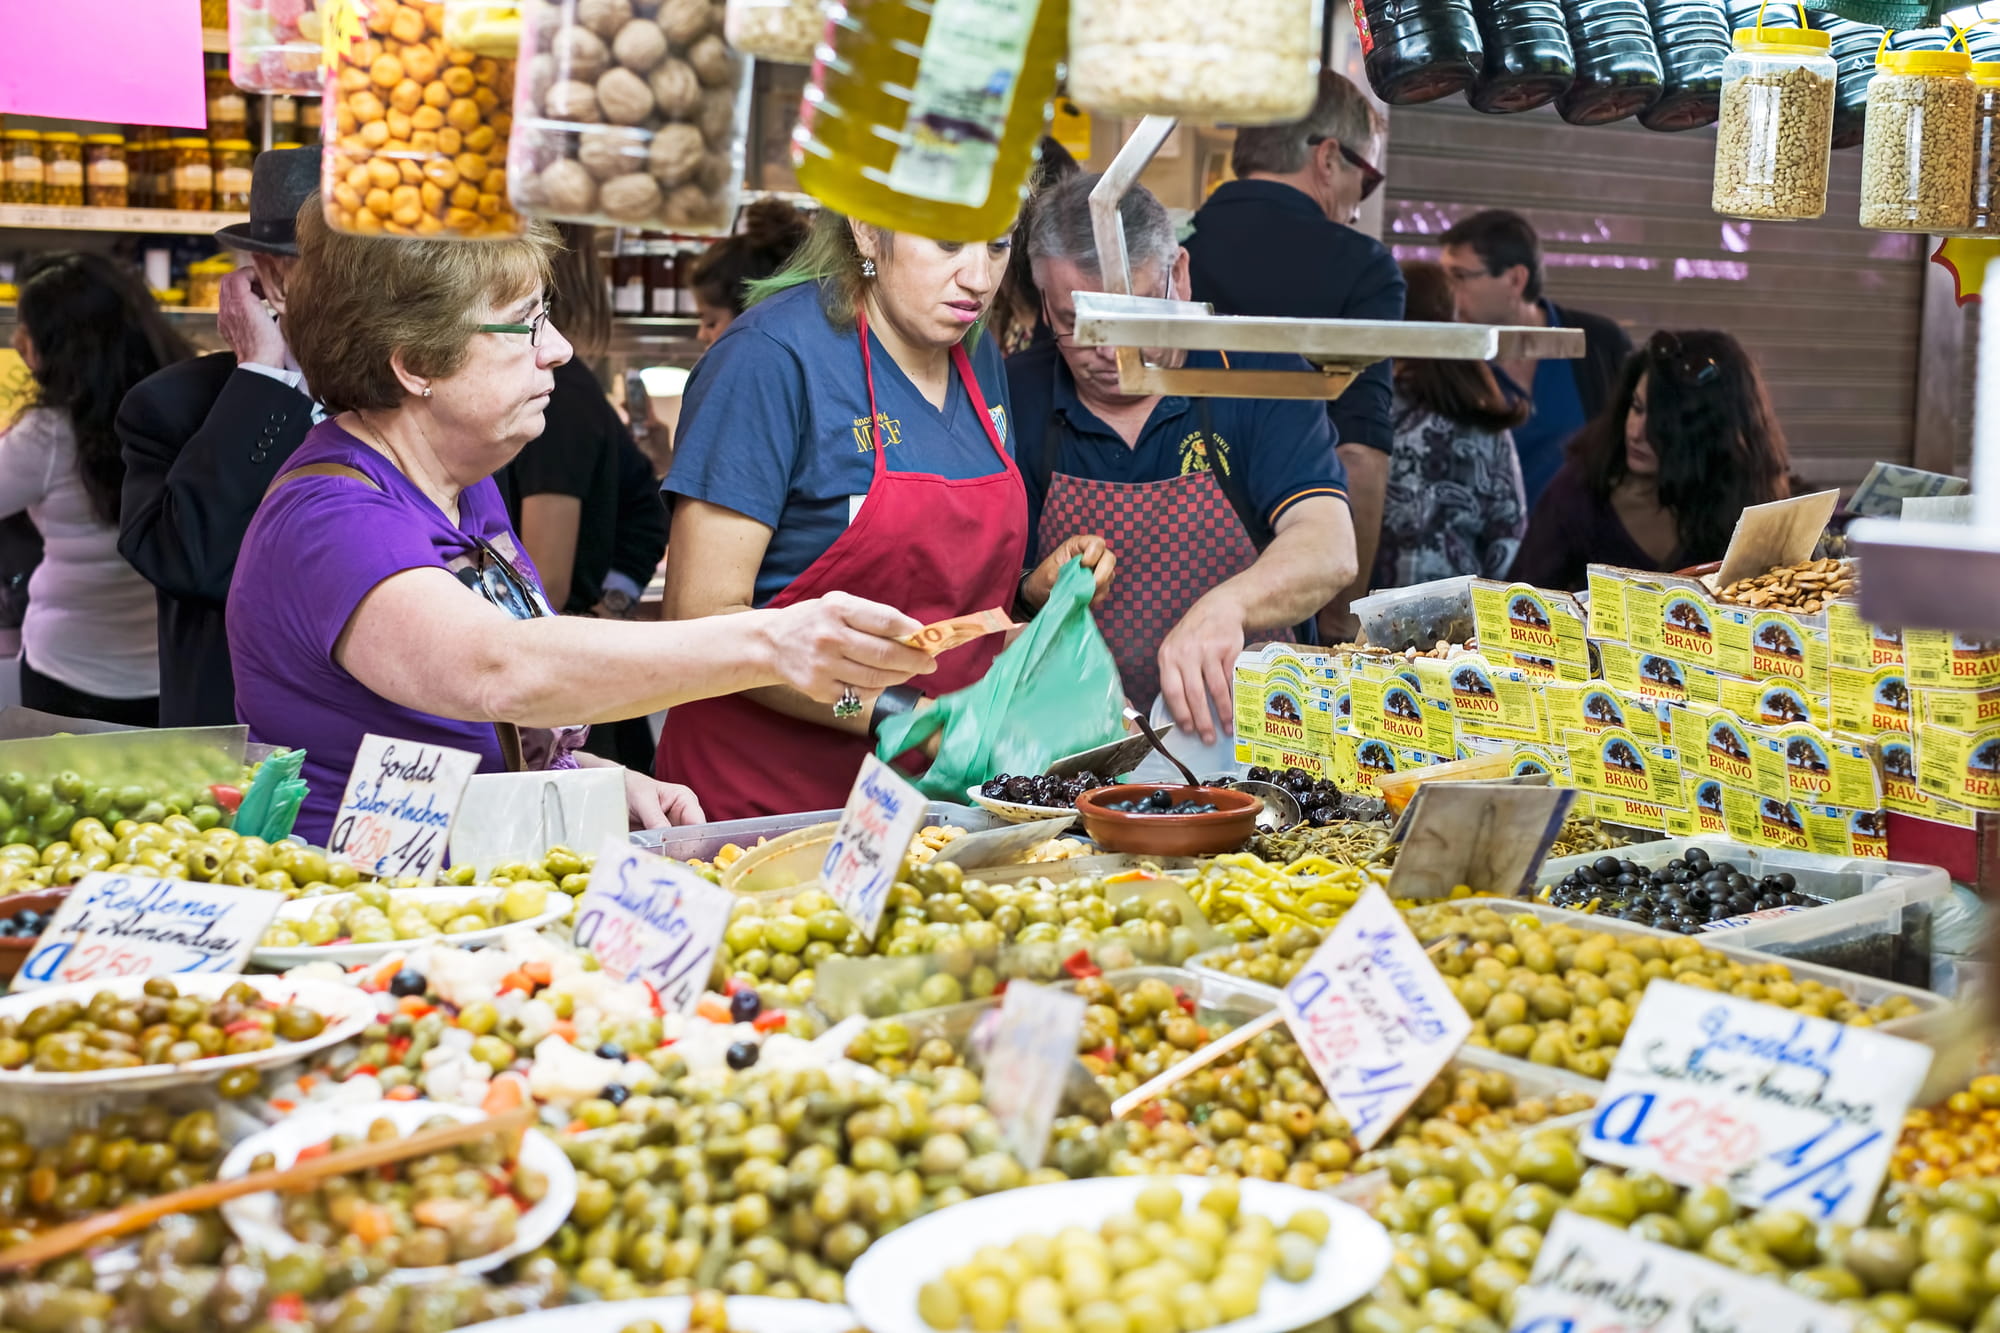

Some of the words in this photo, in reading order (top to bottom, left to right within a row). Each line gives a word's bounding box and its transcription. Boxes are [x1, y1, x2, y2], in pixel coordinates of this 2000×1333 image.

[911, 627, 943, 648] 10
[1511, 627, 1553, 647] BRAVO
[1664, 632, 1713, 655] BRAVO
[1872, 649, 1904, 664] BRA
[1952, 657, 2000, 676] BRAV
[1753, 656, 1804, 679] BRAVO
[1454, 697, 1499, 713] BRAVO
[1265, 721, 1304, 740] BRAVO
[1383, 718, 1423, 738] BRAVO
[376, 744, 443, 788] Gordal
[1282, 752, 1322, 772] BRAVO
[1709, 755, 1753, 780] BRAVO
[1604, 771, 1648, 791] BRAVO
[1789, 775, 1831, 793] RAVO
[1965, 778, 2000, 797] BRA
[345, 780, 393, 813] Sabor
[1885, 781, 1929, 804] RAVO
[1625, 801, 1663, 818] BRAV
[1700, 815, 1726, 832] BRA
[1762, 825, 1808, 849] BRAVO
[392, 826, 438, 878] 1/4
[1852, 842, 1888, 858] BRA
[1338, 1060, 1415, 1135] 1/4
[1762, 1116, 1884, 1219] 1/4
